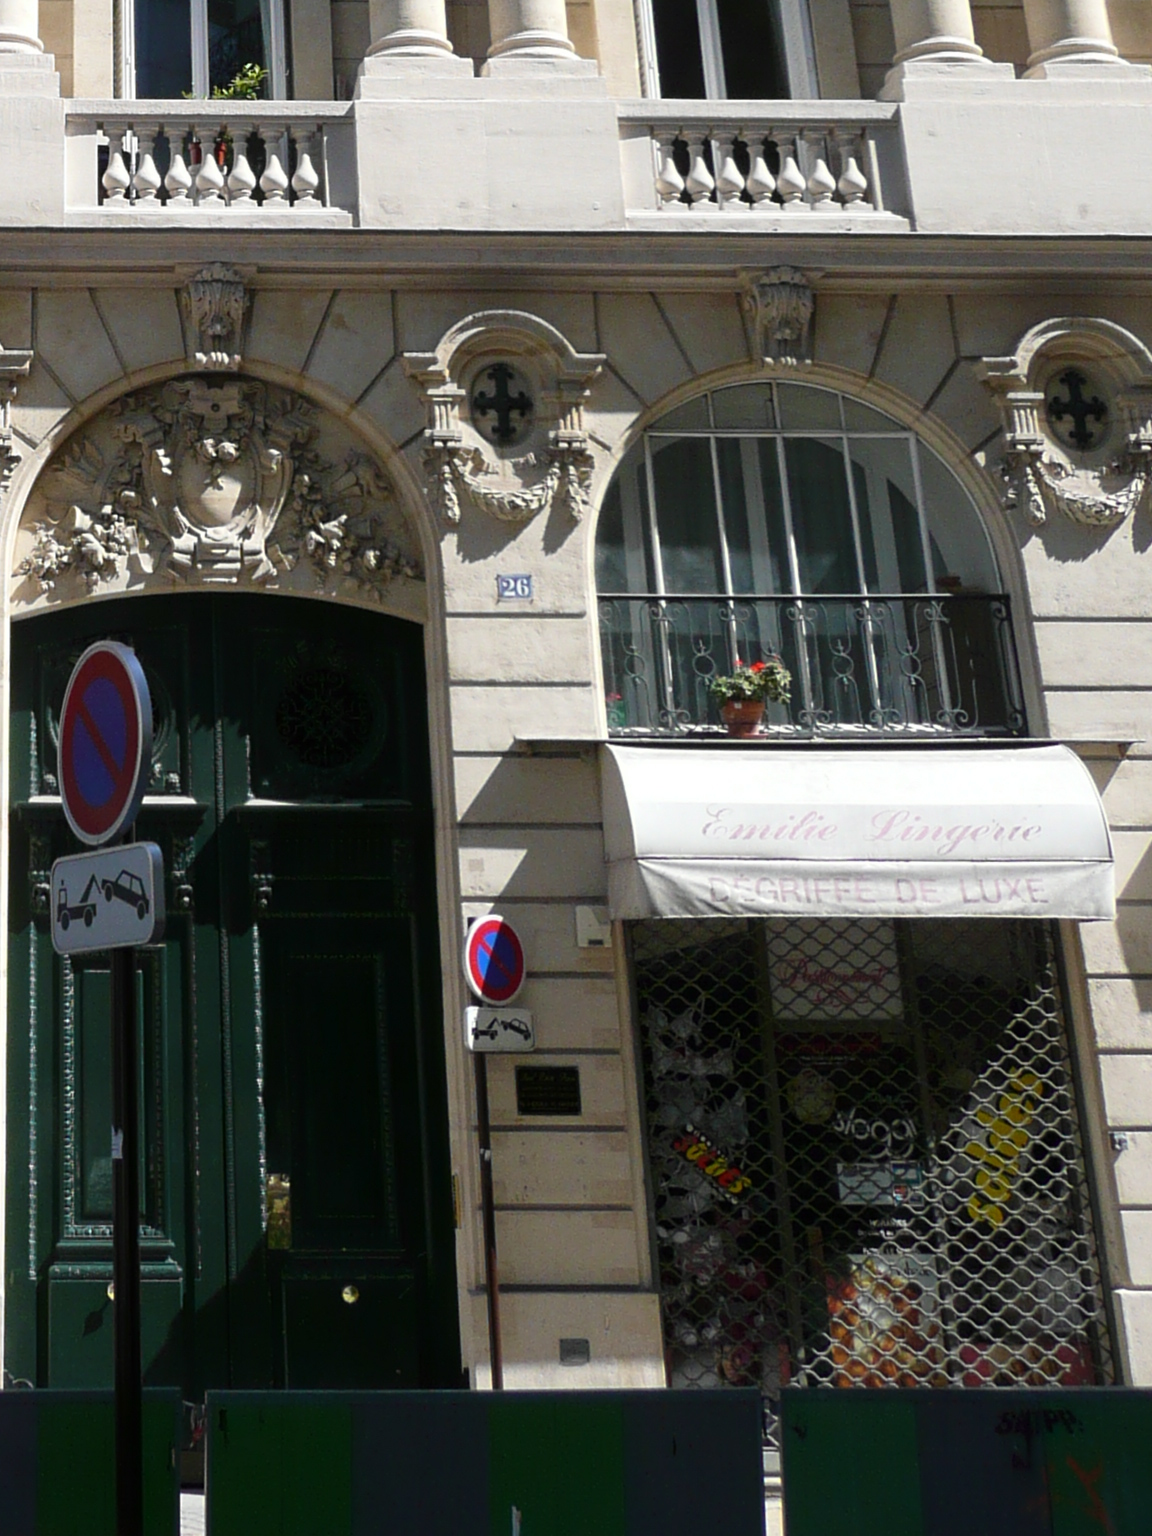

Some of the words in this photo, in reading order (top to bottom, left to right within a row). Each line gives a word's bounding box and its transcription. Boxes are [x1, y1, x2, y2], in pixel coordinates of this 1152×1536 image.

[501, 577, 530, 597] 26
[701, 803, 840, 842] Emilie
[862, 809, 1043, 856] Lingerie
[894, 875, 941, 905] DE
[959, 876, 1050, 905] LUXE
